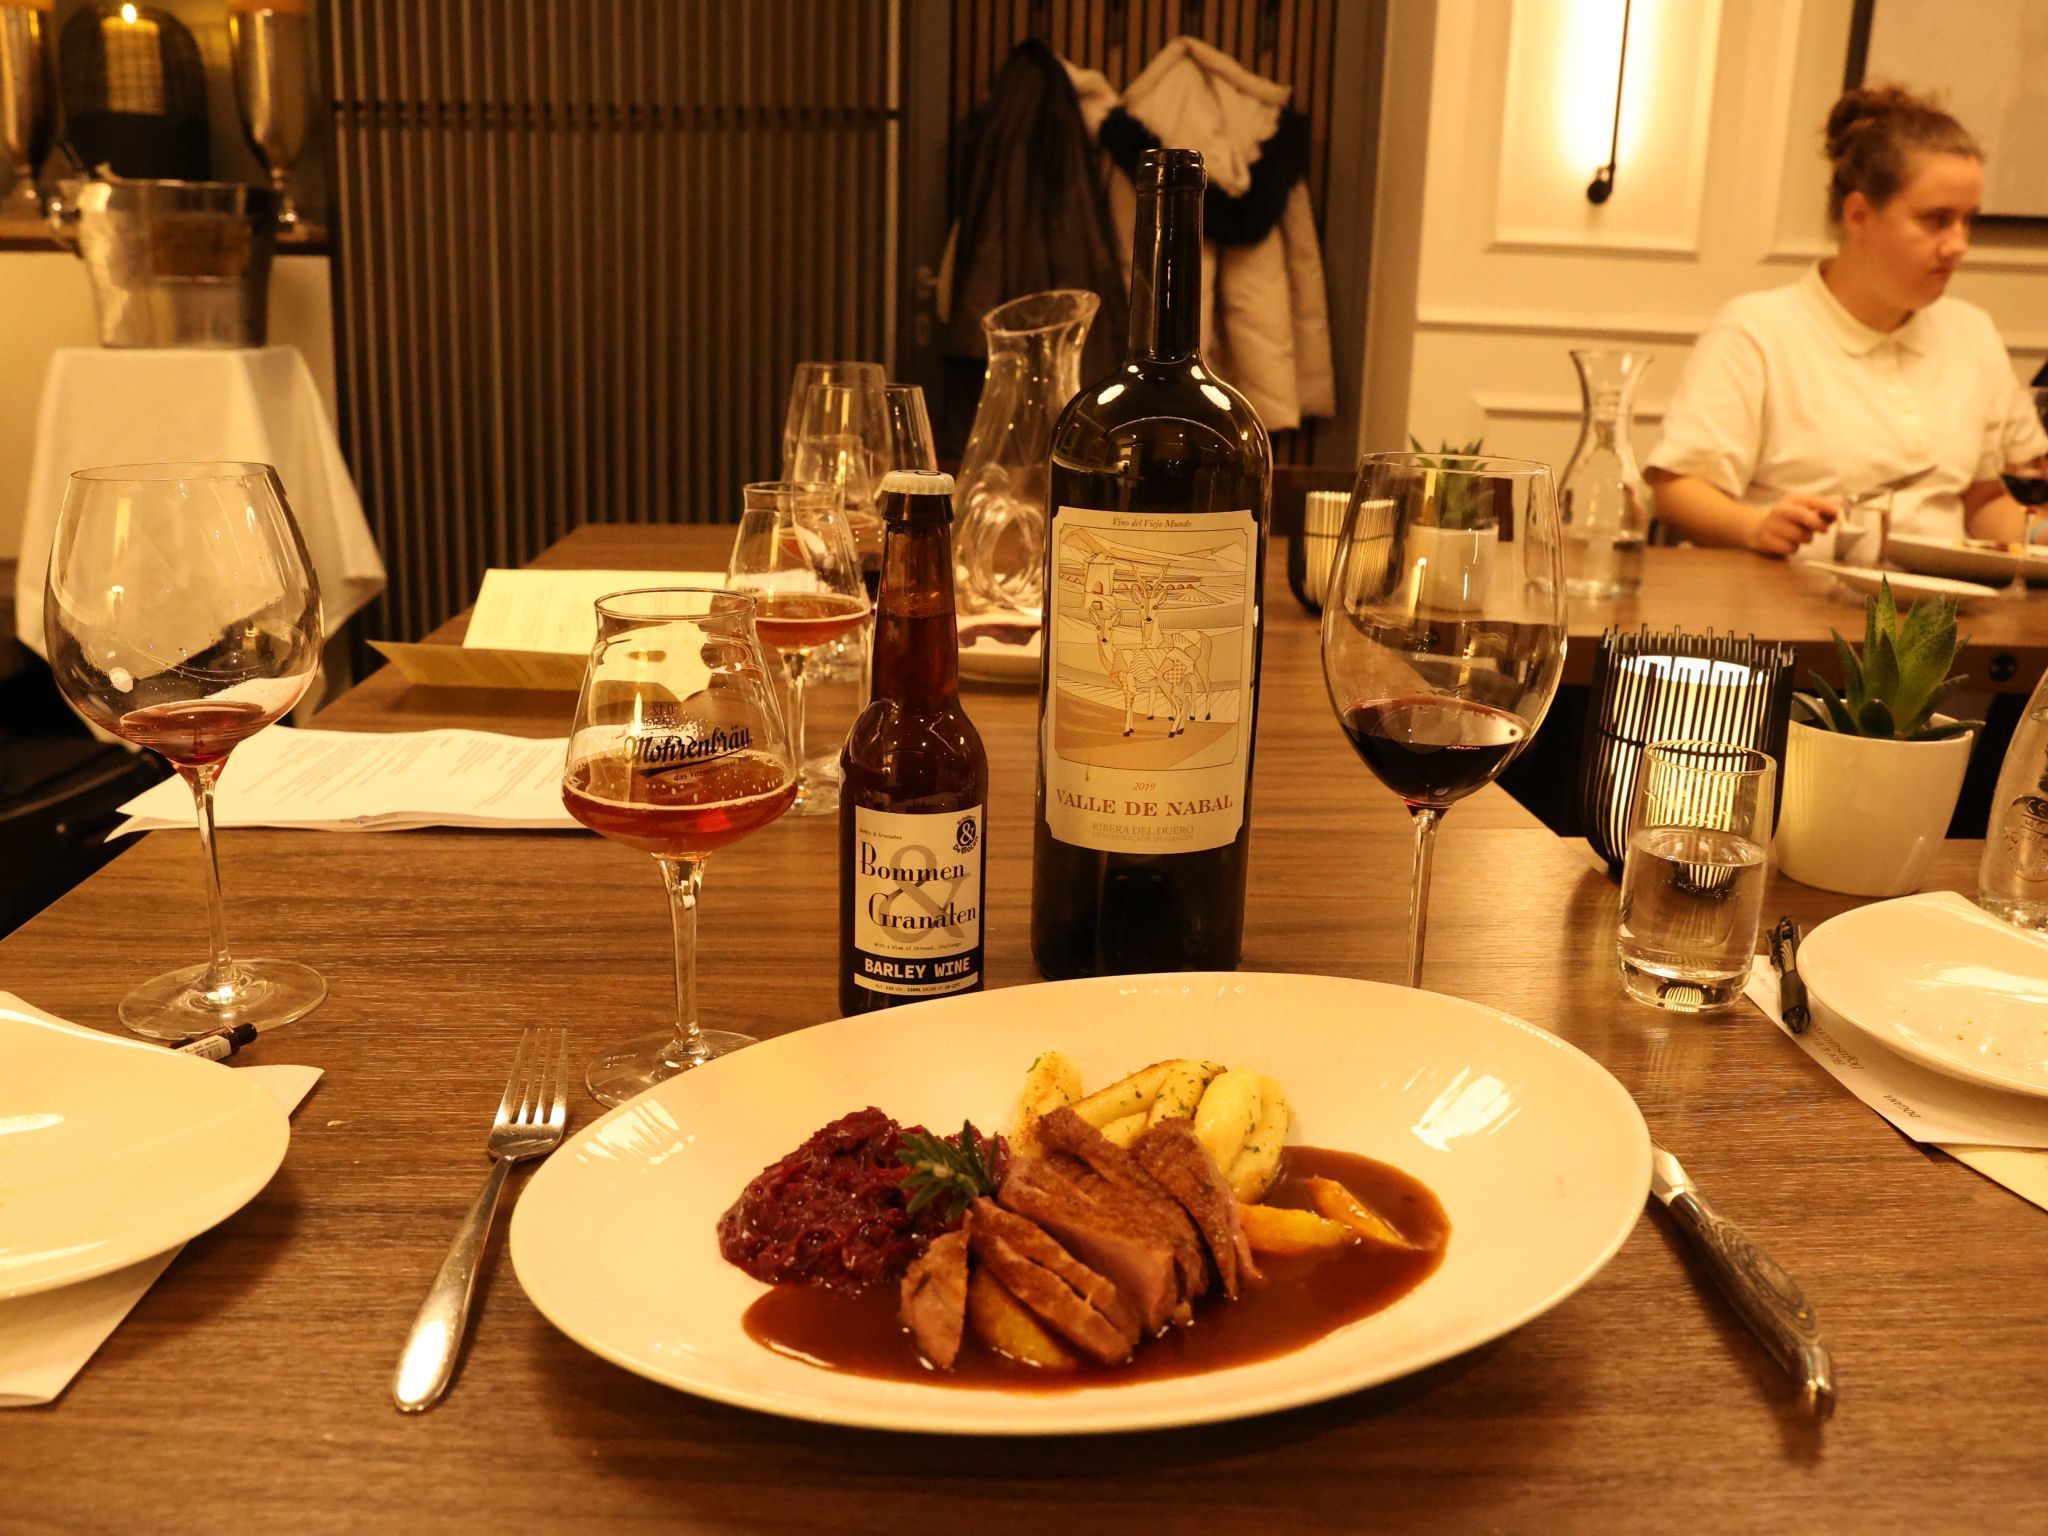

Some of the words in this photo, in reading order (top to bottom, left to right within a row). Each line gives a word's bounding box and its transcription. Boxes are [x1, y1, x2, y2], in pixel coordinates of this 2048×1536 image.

[1112, 517, 1130, 528] Vino
[1131, 518, 1143, 528] del
[1144, 518, 1163, 530] Viejo
[1164, 519, 1192, 529] Mundo
[624, 725, 753, 764] Mohrenbräu
[1132, 782, 1157, 792] 2019
[1056, 788, 1117, 815] VALLE
[1125, 801, 1158, 818] DE
[1165, 794, 1234, 817] NABAL
[960, 822, 975, 844] &
[1091, 822, 1130, 835] RIBERA
[1132, 825, 1155, 836] DEL
[1156, 825, 1195, 836] DUERO
[860, 841, 965, 882] Bommen
[878, 845, 971, 944] &
[868, 892, 976, 930] Granaten
[864, 958, 927, 979] BARLEY
[934, 956, 970, 978] WINE
